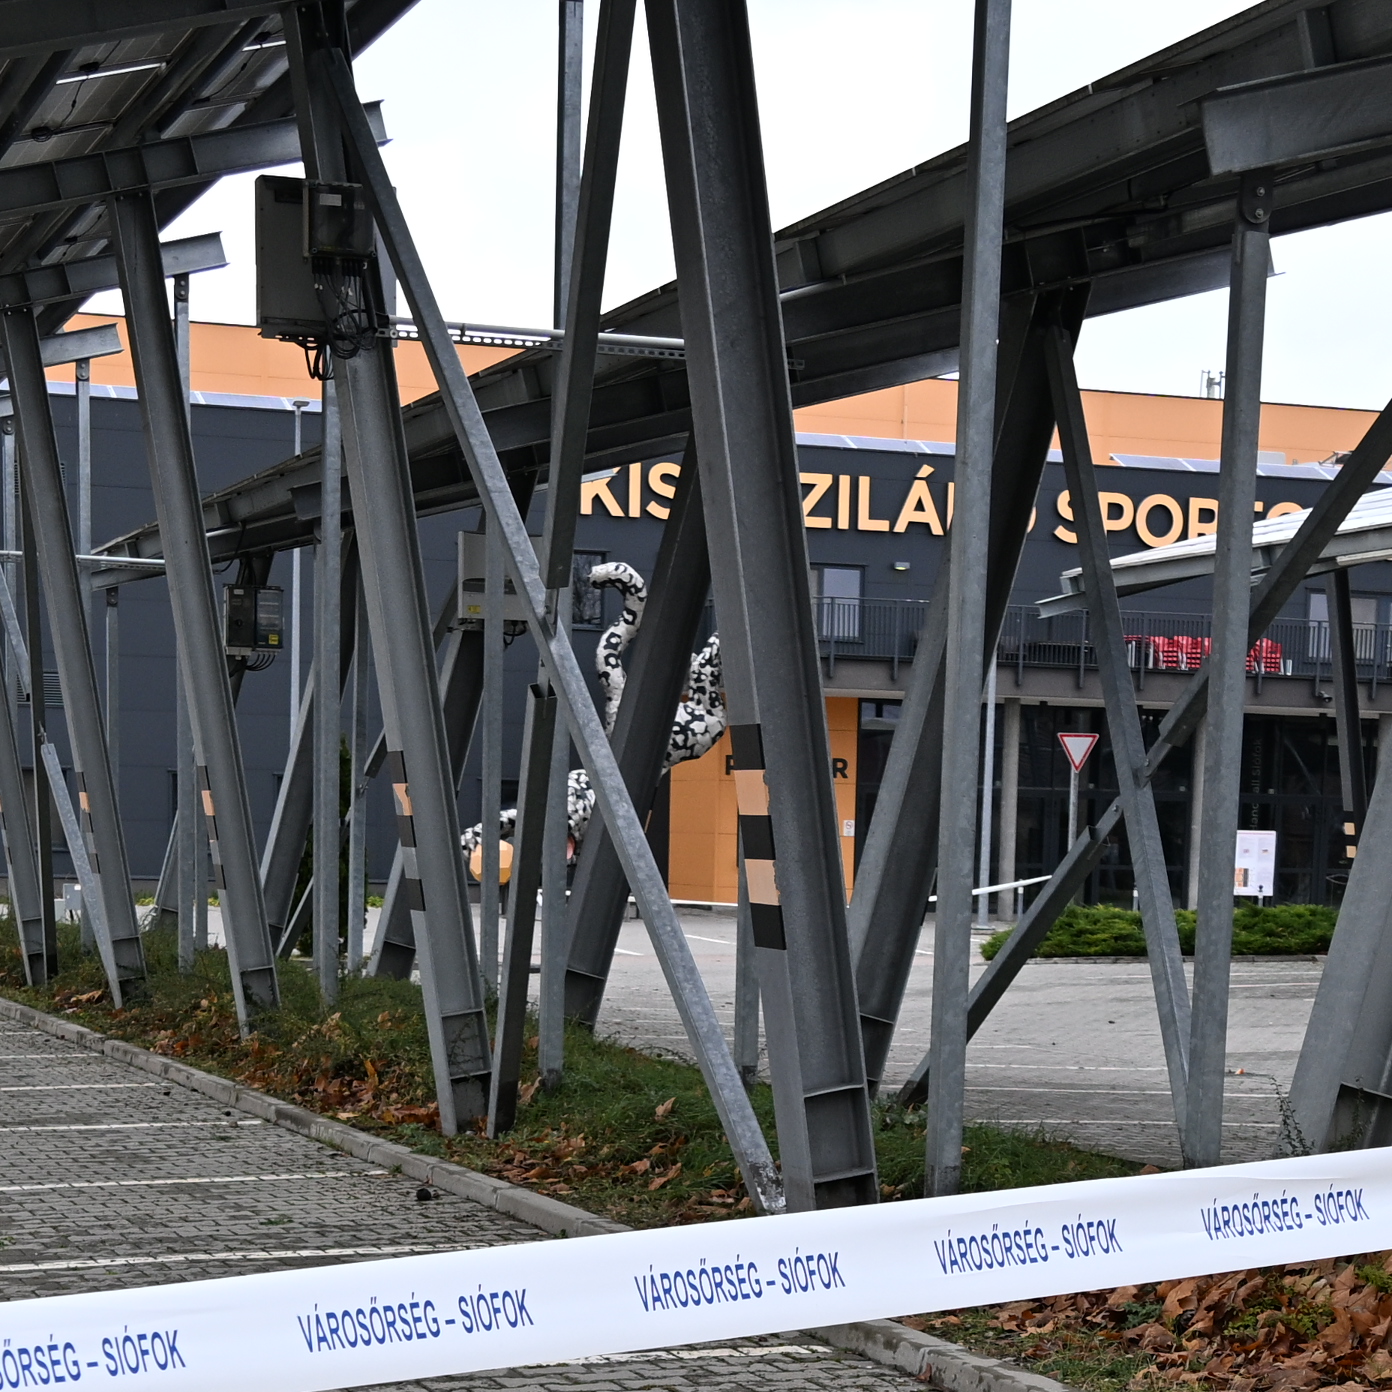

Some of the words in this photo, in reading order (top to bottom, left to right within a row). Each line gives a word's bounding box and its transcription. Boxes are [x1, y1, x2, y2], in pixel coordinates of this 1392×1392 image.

[580, 462, 681, 520] KIS
[798, 464, 1036, 536] ZILÁ
[1201, 1189, 1303, 1240] VÁROSŐRSÉG
[1314, 1183, 1370, 1226] SIÓFOK
[934, 1220, 1049, 1275] VÁROSŐRSÉG
[1061, 1213, 1123, 1259] SIÓFOK
[634, 1254, 763, 1312] VÁROSŐRSÉG
[778, 1247, 846, 1295] SIÓFOK
[297, 1292, 441, 1353] VÁROSŐRSÉG
[458, 1284, 534, 1334] SIÓFOK
[102, 1325, 186, 1377] SIÓFOK
